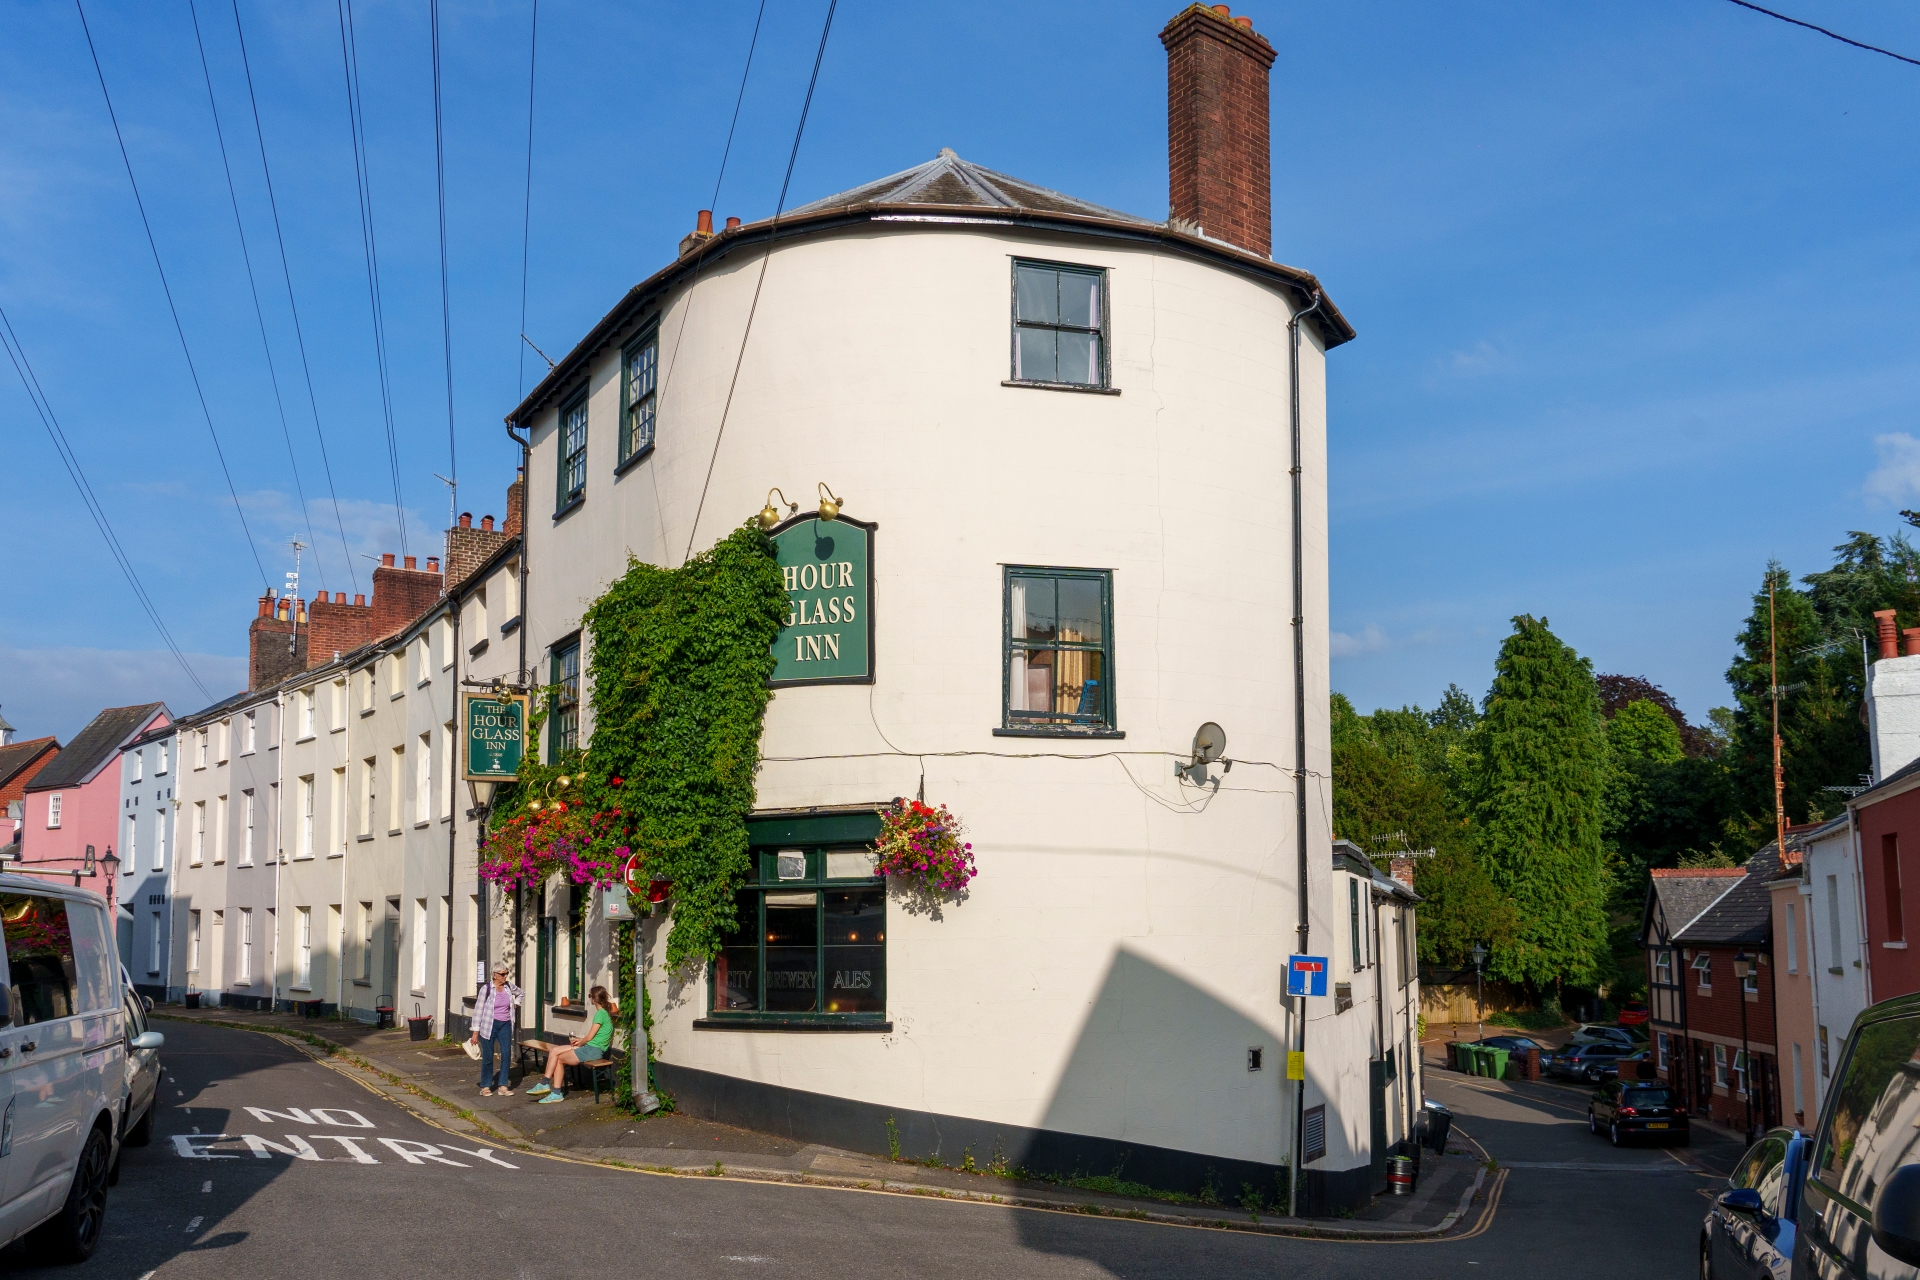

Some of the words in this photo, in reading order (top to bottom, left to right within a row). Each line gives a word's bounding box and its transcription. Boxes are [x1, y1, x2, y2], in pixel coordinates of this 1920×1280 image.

[781, 561, 855, 591] HOUR
[795, 633, 841, 662] INN
[484, 705, 506, 714] THE
[473, 714, 518, 728] HOUR
[472, 728, 520, 740] GLASS
[486, 741, 506, 750] INN
[766, 970, 817, 988] BREWERY
[833, 970, 871, 989] ALES
[243, 1106, 376, 1129] NO
[171, 1134, 520, 1169] ENTRY
